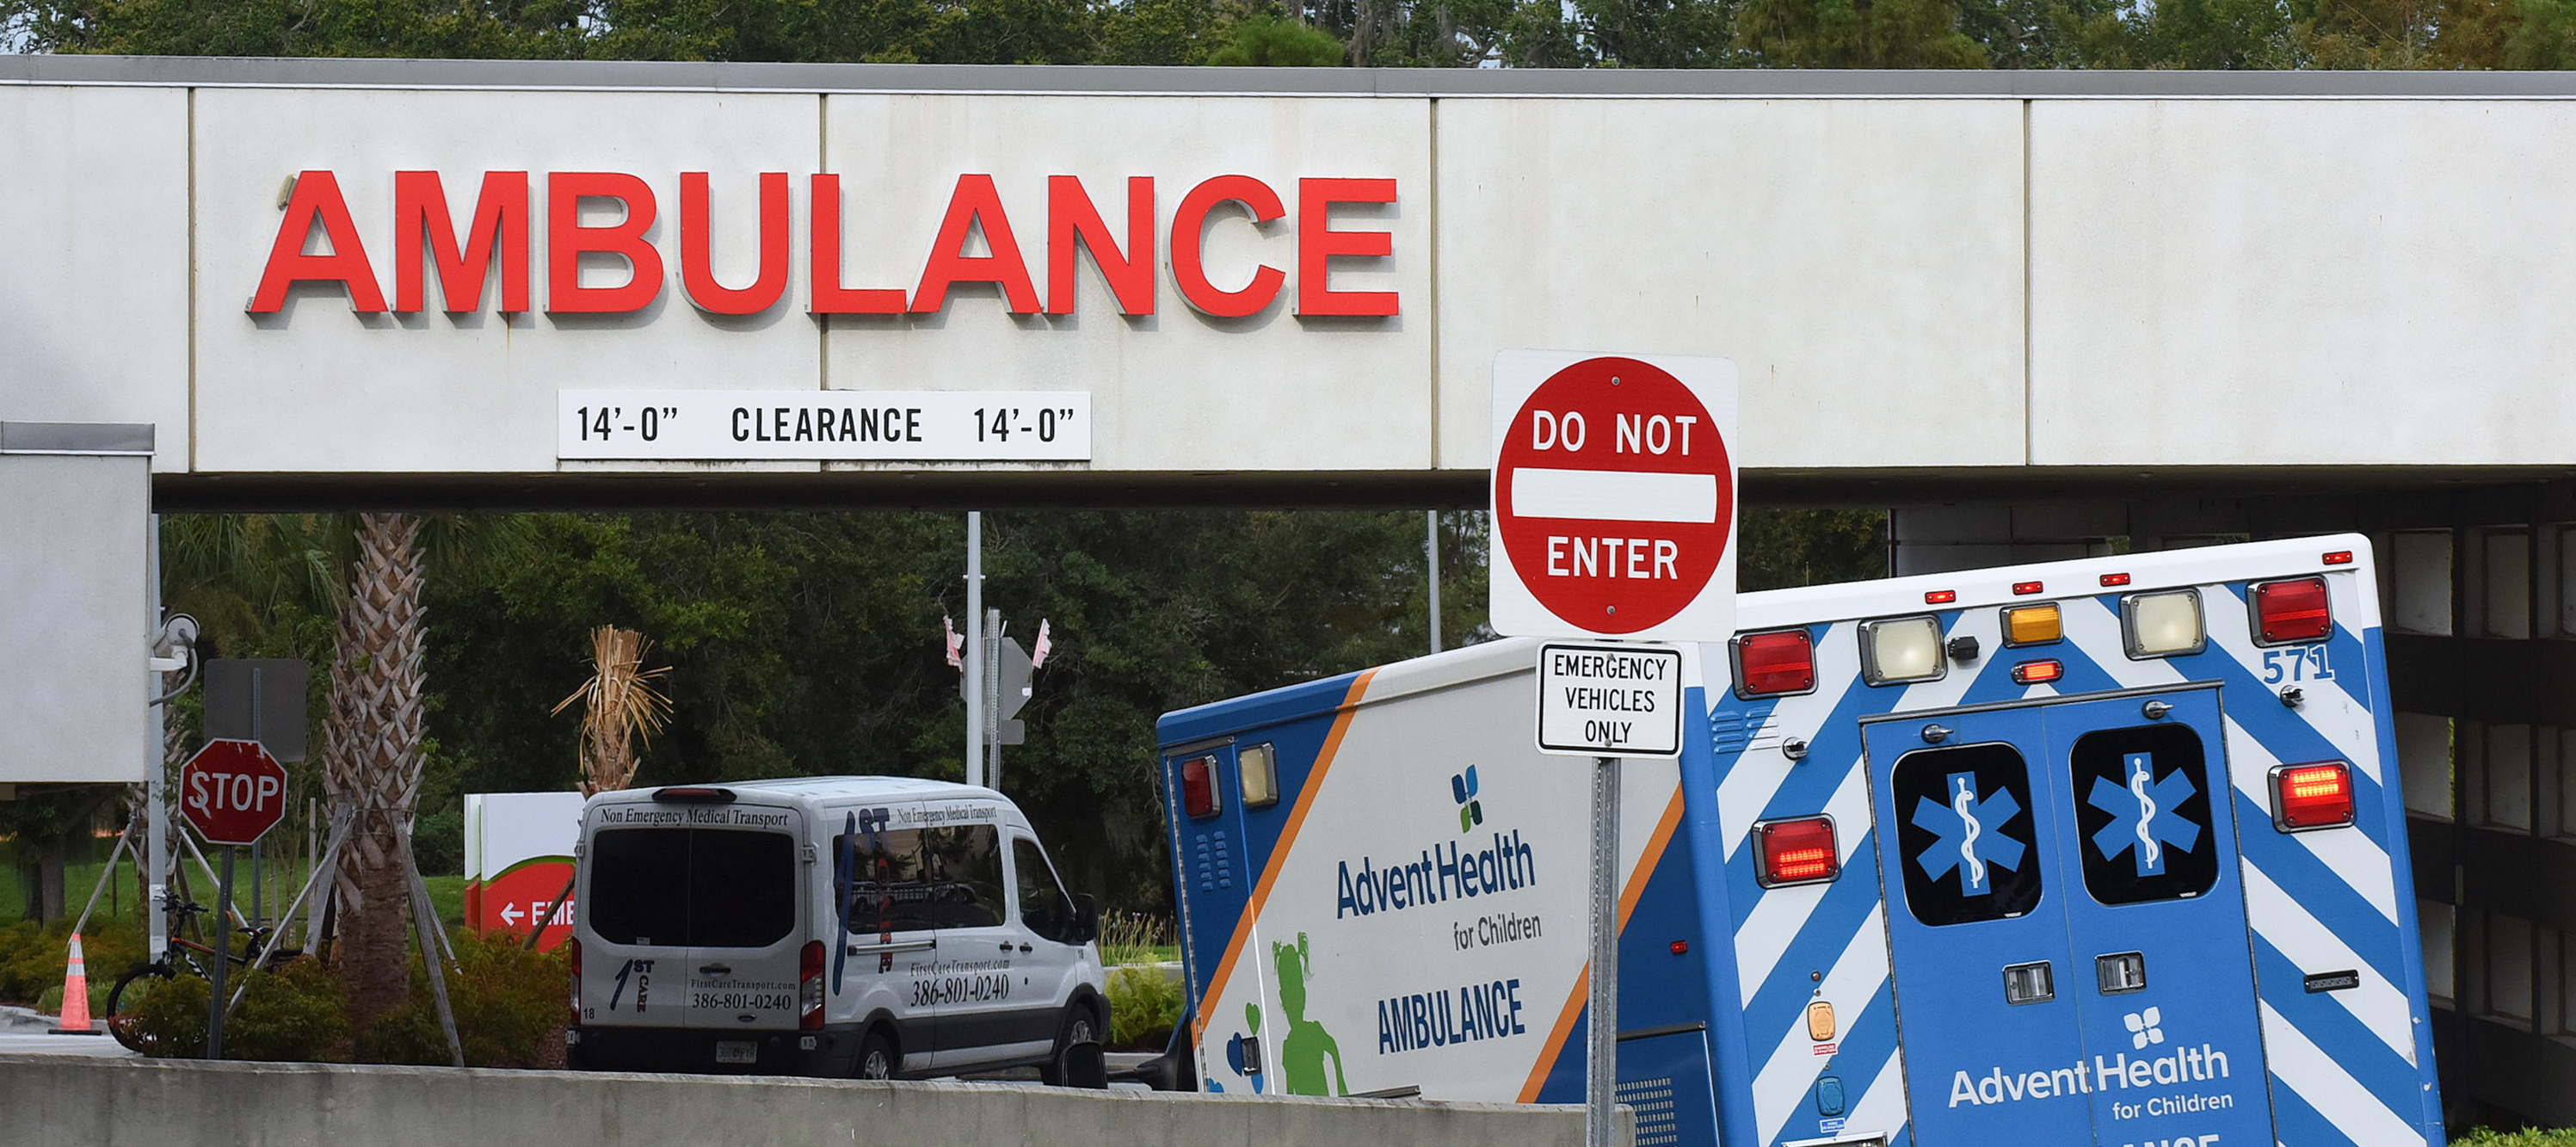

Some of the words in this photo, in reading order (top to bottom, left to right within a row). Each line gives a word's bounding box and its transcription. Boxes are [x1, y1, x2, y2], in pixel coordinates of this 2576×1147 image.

[249, 170, 1399, 317] AMBULANCE
[731, 407, 922, 442] CLEARANCE
[1532, 410, 1586, 452] DO
[1616, 413, 1697, 456] NOT
[1548, 535, 1679, 580] ENTER
[1554, 654, 1667, 681] EMERGENCY
[2263, 645, 2333, 685] 571
[1565, 686, 1655, 712] VEHICLES
[1584, 719, 1632, 744] ONLY
[188, 771, 280, 812] STOP
[601, 809, 622, 823] Non
[626, 809, 684, 826] Emergency
[686, 810, 730, 824] Medical
[733, 810, 788, 829] Transport
[897, 808, 911, 823] Non
[912, 807, 945, 826] Emergency
[946, 805, 970, 821] Medical
[969, 805, 997, 823] Transport
[1336, 829, 1536, 919] AdventHealth
[1453, 922, 1474, 952] for
[1477, 914, 1542, 947] Children
[691, 978, 796, 991] FirstCareTransport.com
[910, 959, 1010, 977] FirstCareTransport.com
[637, 975, 649, 1013] CARE
[692, 992, 792, 1010] 386-801-0240
[910, 973, 1009, 1007] 386-801-0240
[583, 1008, 595, 1020] 18
[1378, 979, 1525, 1055] AMBULANCE
[1948, 1044, 2229, 1108] AdventHealth
[2112, 1101, 2142, 1120] for
[2147, 1094, 2234, 1117] Children
